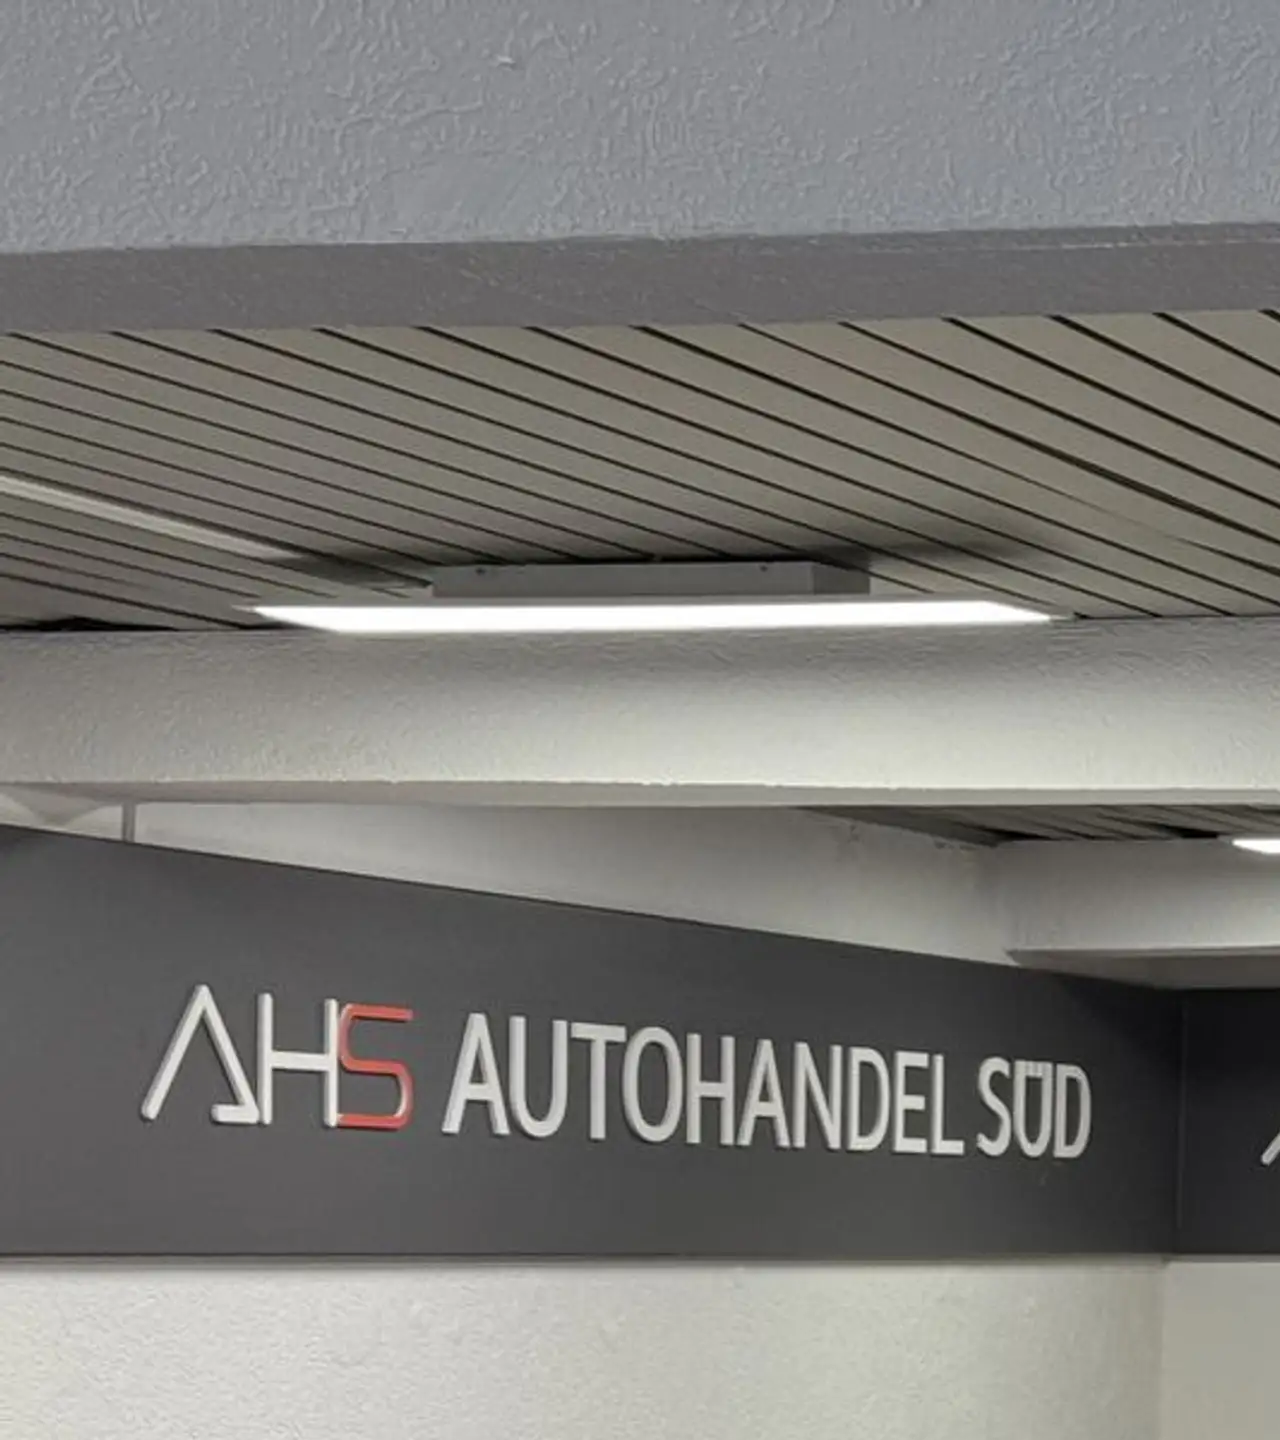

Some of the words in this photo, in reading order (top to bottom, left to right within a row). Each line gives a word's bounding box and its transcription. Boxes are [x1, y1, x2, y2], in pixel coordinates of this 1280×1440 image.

[141, 984, 414, 1130] AHS
[441, 1012, 965, 1156] AUTOHANDEL
[976, 1057, 1091, 1159] SÜD
